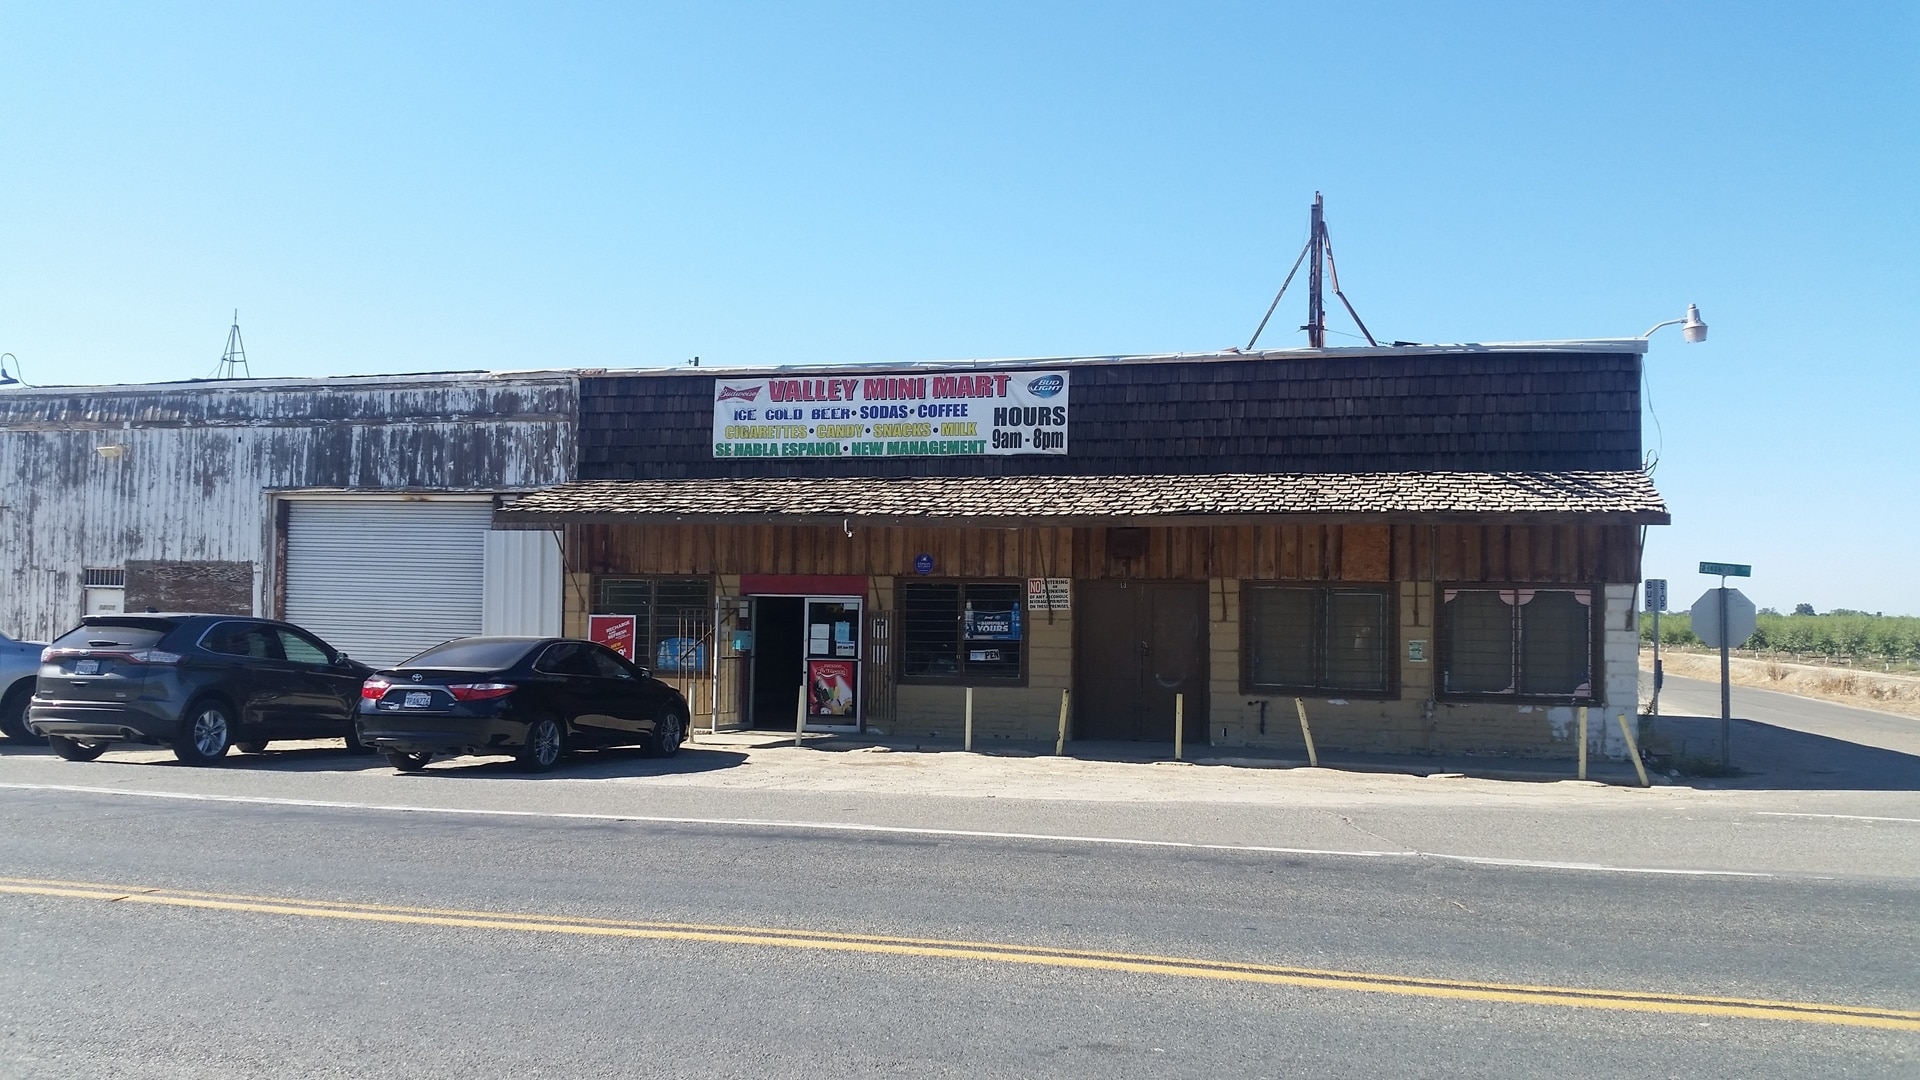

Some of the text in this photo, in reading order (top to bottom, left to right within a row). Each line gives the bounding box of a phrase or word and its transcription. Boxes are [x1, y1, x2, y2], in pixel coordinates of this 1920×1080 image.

[720, 388, 757, 398] Budweiser
[769, 375, 1011, 402] VALLEY MINI MART
[734, 404, 968, 421] ICE COLD BEER SODAS COFFEE
[993, 406, 1066, 427] HOURS
[725, 422, 977, 439] CIGARETTES CANDY SNACKS MILK
[992, 429, 1022, 448] 9am
[1033, 428, 1063, 450] 8pm
[716, 440, 987, 456] SE HABLA ESPANOL NEW MANAGEMENT
[1030, 581, 1041, 593] NO
